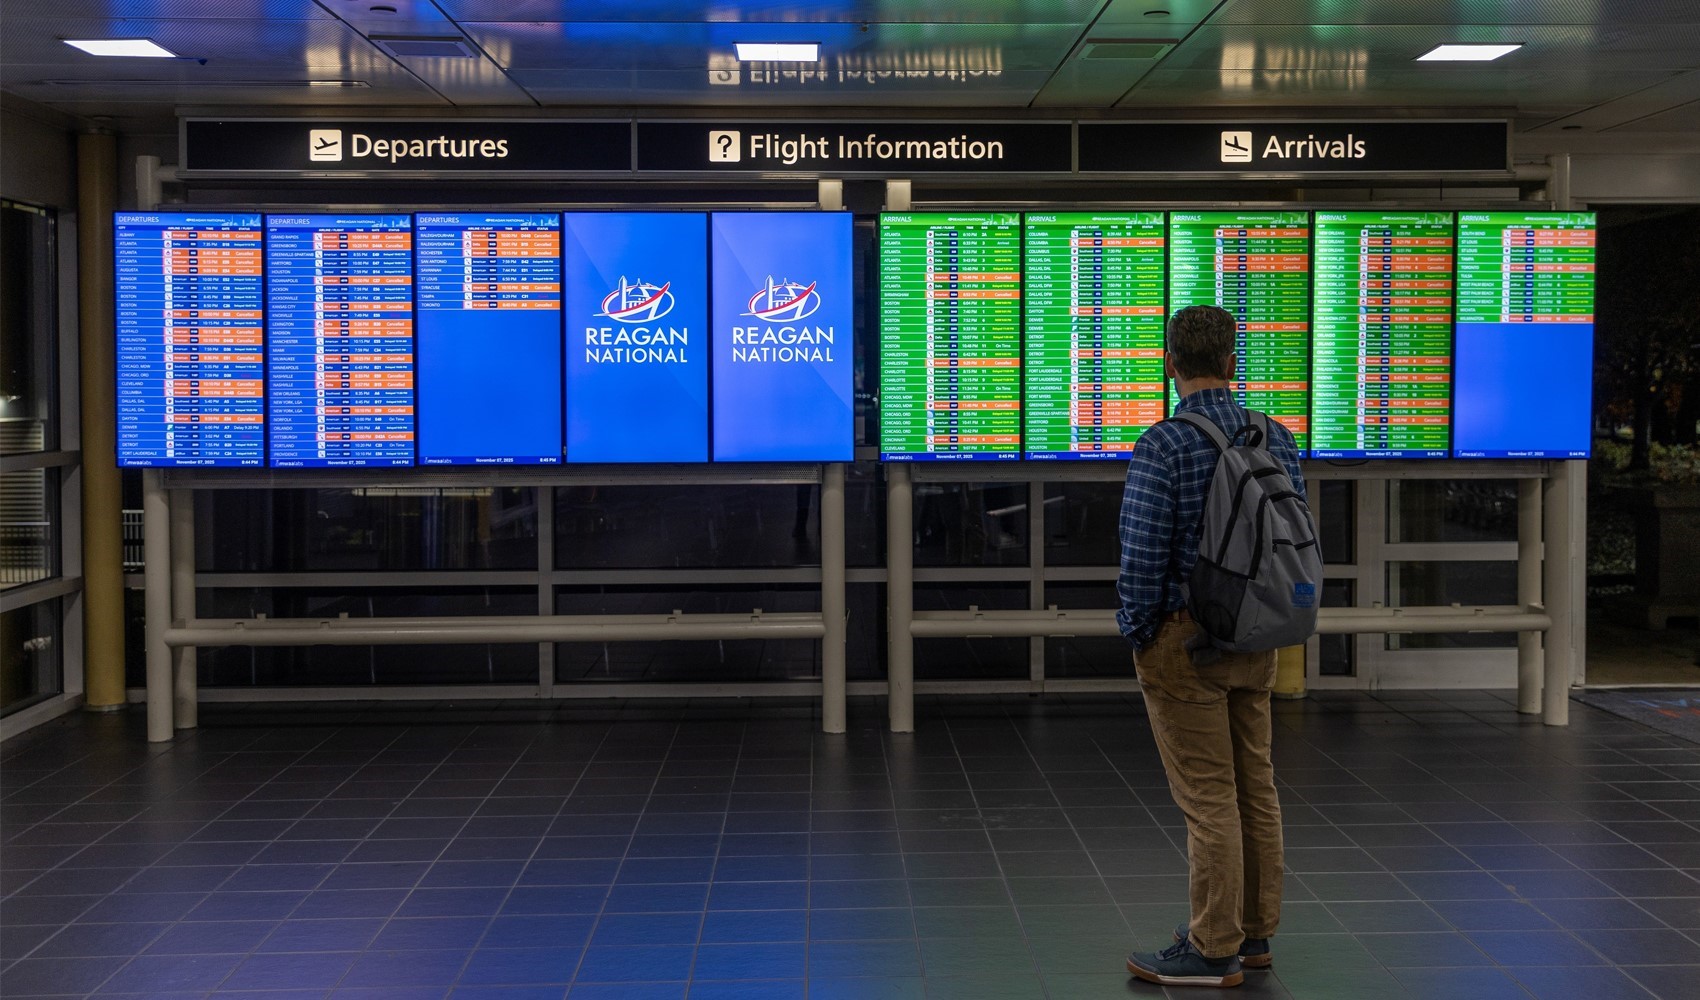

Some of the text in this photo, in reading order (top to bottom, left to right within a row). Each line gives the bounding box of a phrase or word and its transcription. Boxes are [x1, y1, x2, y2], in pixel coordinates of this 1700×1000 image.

[352, 134, 508, 163] Departures
[750, 134, 1003, 164] Flight Information
[1262, 135, 1366, 158] Arrivals
[586, 328, 687, 345] REAGAN
[733, 327, 833, 344] REAGAN
[586, 348, 687, 362] NATIONAL
[733, 348, 833, 362] NATIONAL
